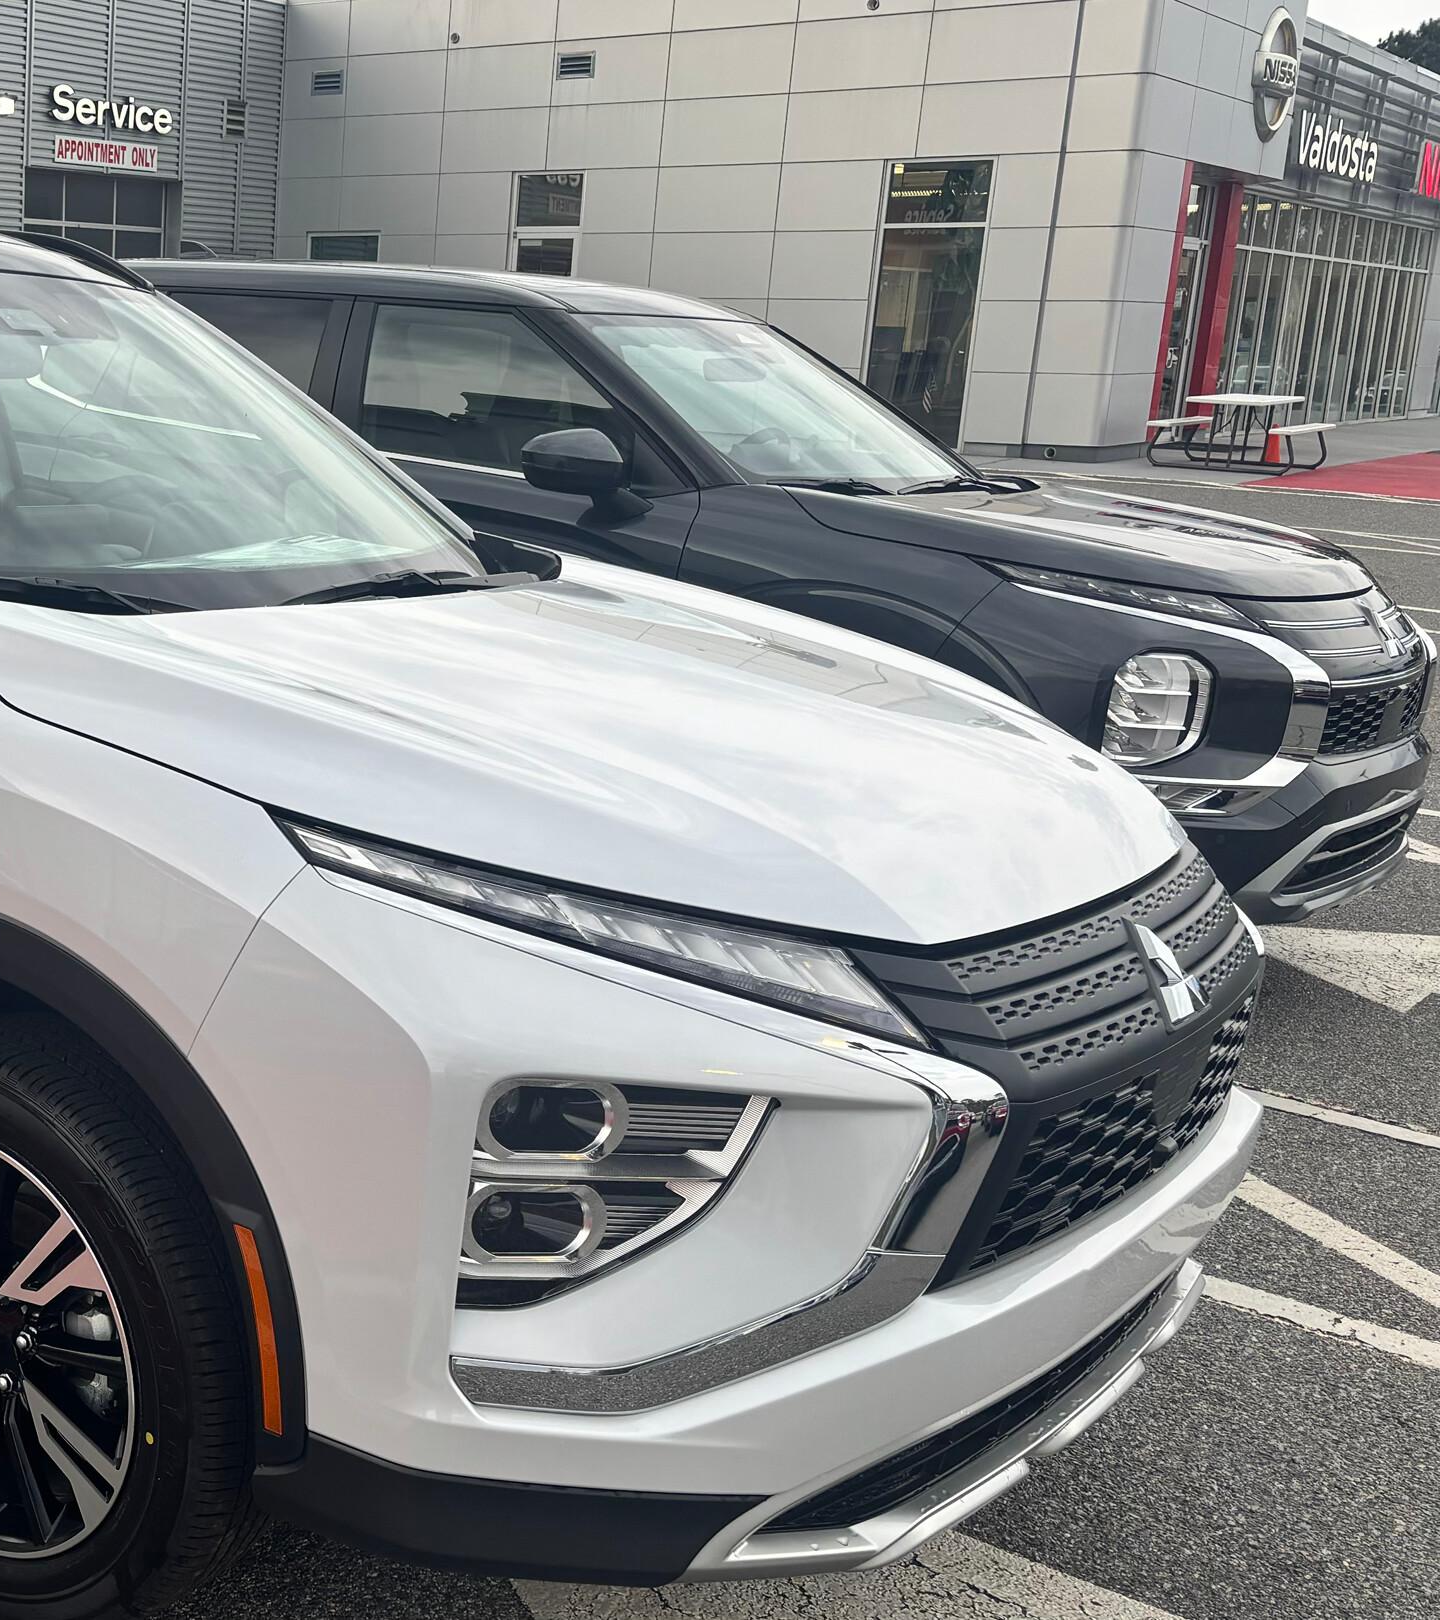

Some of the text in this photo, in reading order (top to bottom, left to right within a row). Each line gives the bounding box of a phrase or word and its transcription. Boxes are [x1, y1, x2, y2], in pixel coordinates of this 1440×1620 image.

[1263, 57, 1297, 88] NISS
[51, 83, 173, 134] Service
[56, 138, 157, 168] APPOINTMENT ONLY
[1299, 109, 1378, 183] Valdosta
